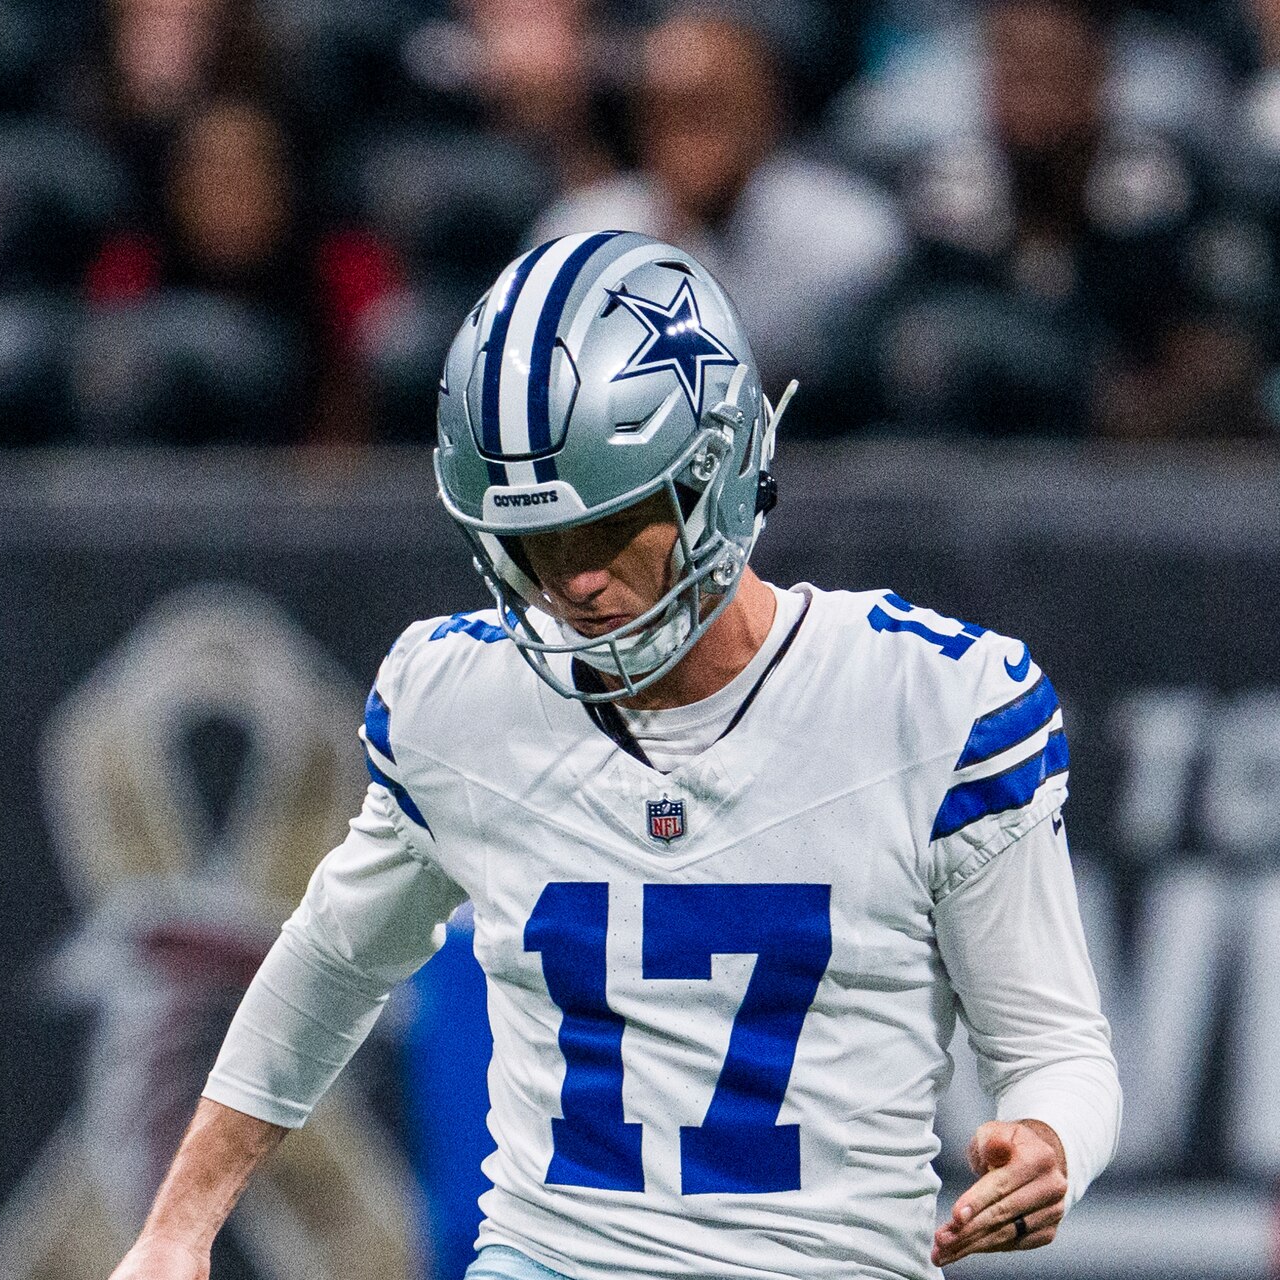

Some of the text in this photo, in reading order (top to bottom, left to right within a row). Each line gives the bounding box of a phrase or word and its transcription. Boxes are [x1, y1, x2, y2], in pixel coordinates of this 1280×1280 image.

[493, 489, 559, 507] COWBOYS
[652, 816, 682, 836] NFL
[524, 881, 833, 1196] 17
